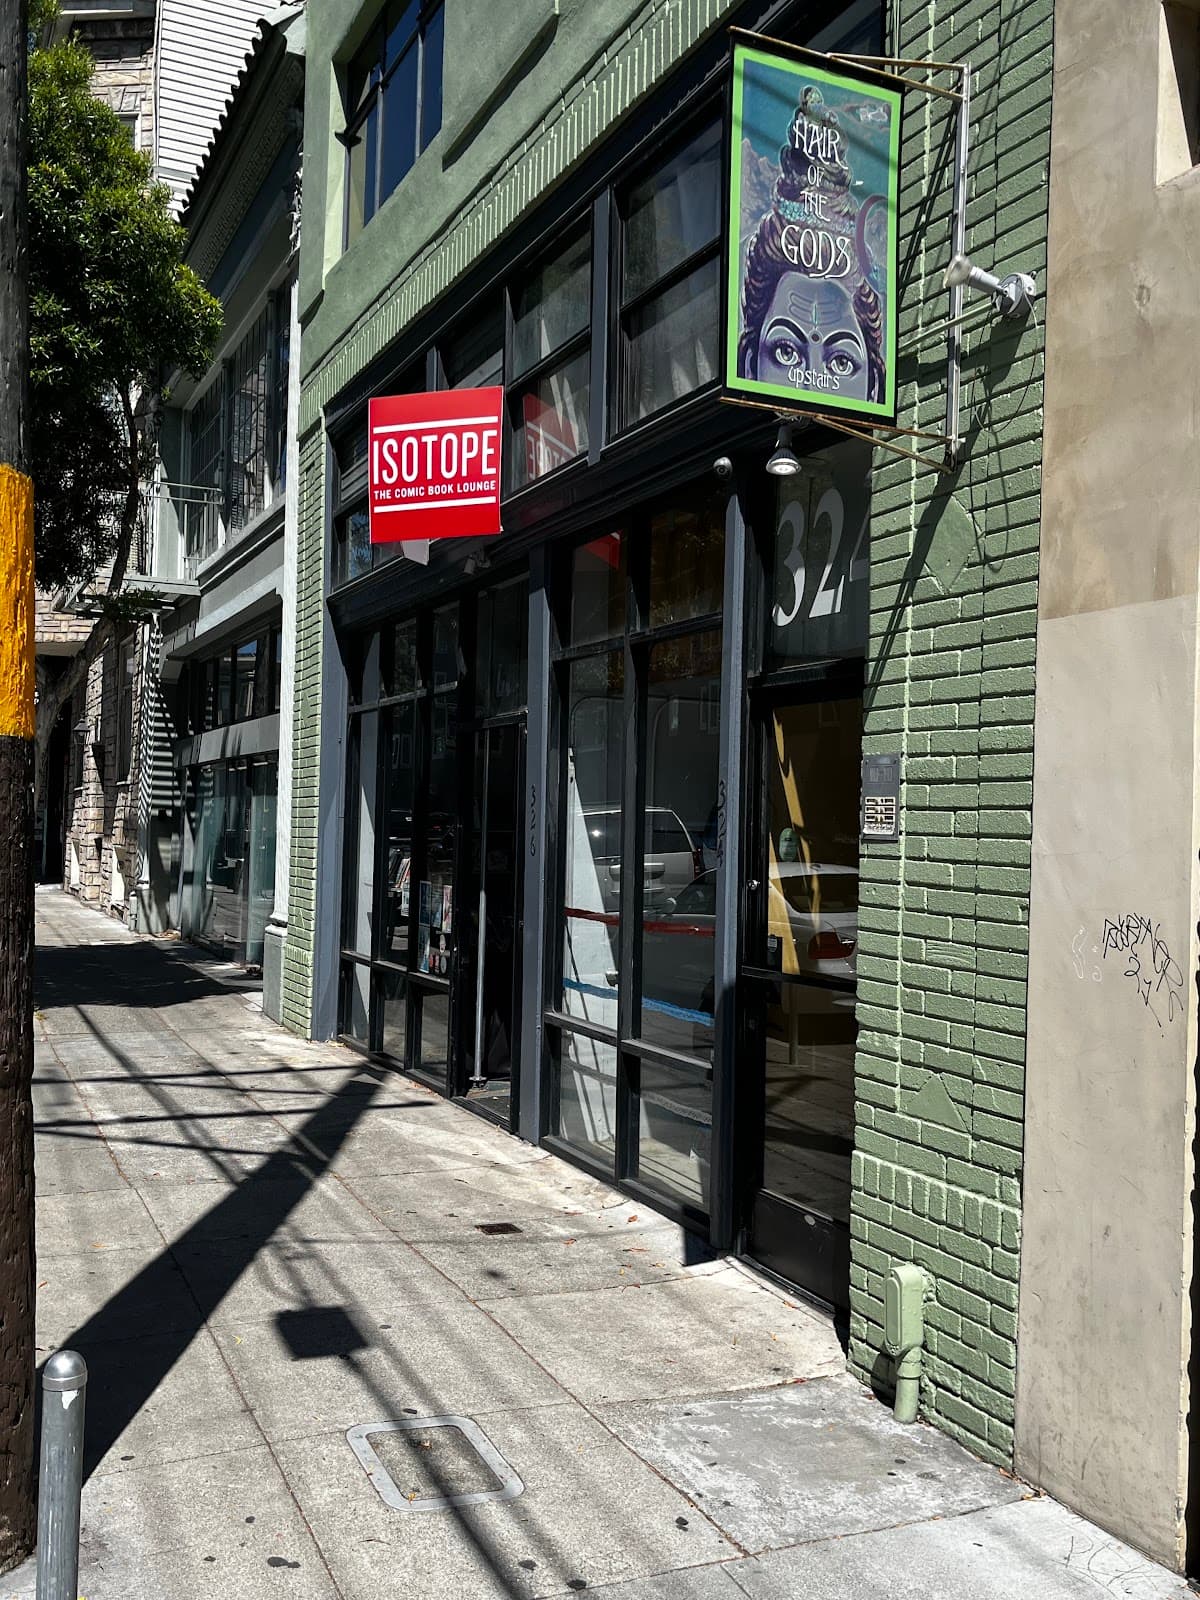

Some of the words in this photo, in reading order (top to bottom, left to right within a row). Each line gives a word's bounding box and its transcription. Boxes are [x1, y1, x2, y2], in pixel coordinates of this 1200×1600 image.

[793, 119, 848, 169] HAIR
[807, 164, 825, 187] OF
[800, 190, 831, 222] THE
[781, 224, 851, 278] GODS
[788, 366, 840, 390] upstairs
[373, 430, 498, 485] ISOTOPE
[373, 489, 392, 500] THE
[394, 486, 425, 499] COMIC
[428, 484, 454, 496] BOOK
[457, 480, 497, 493] LOUNGE
